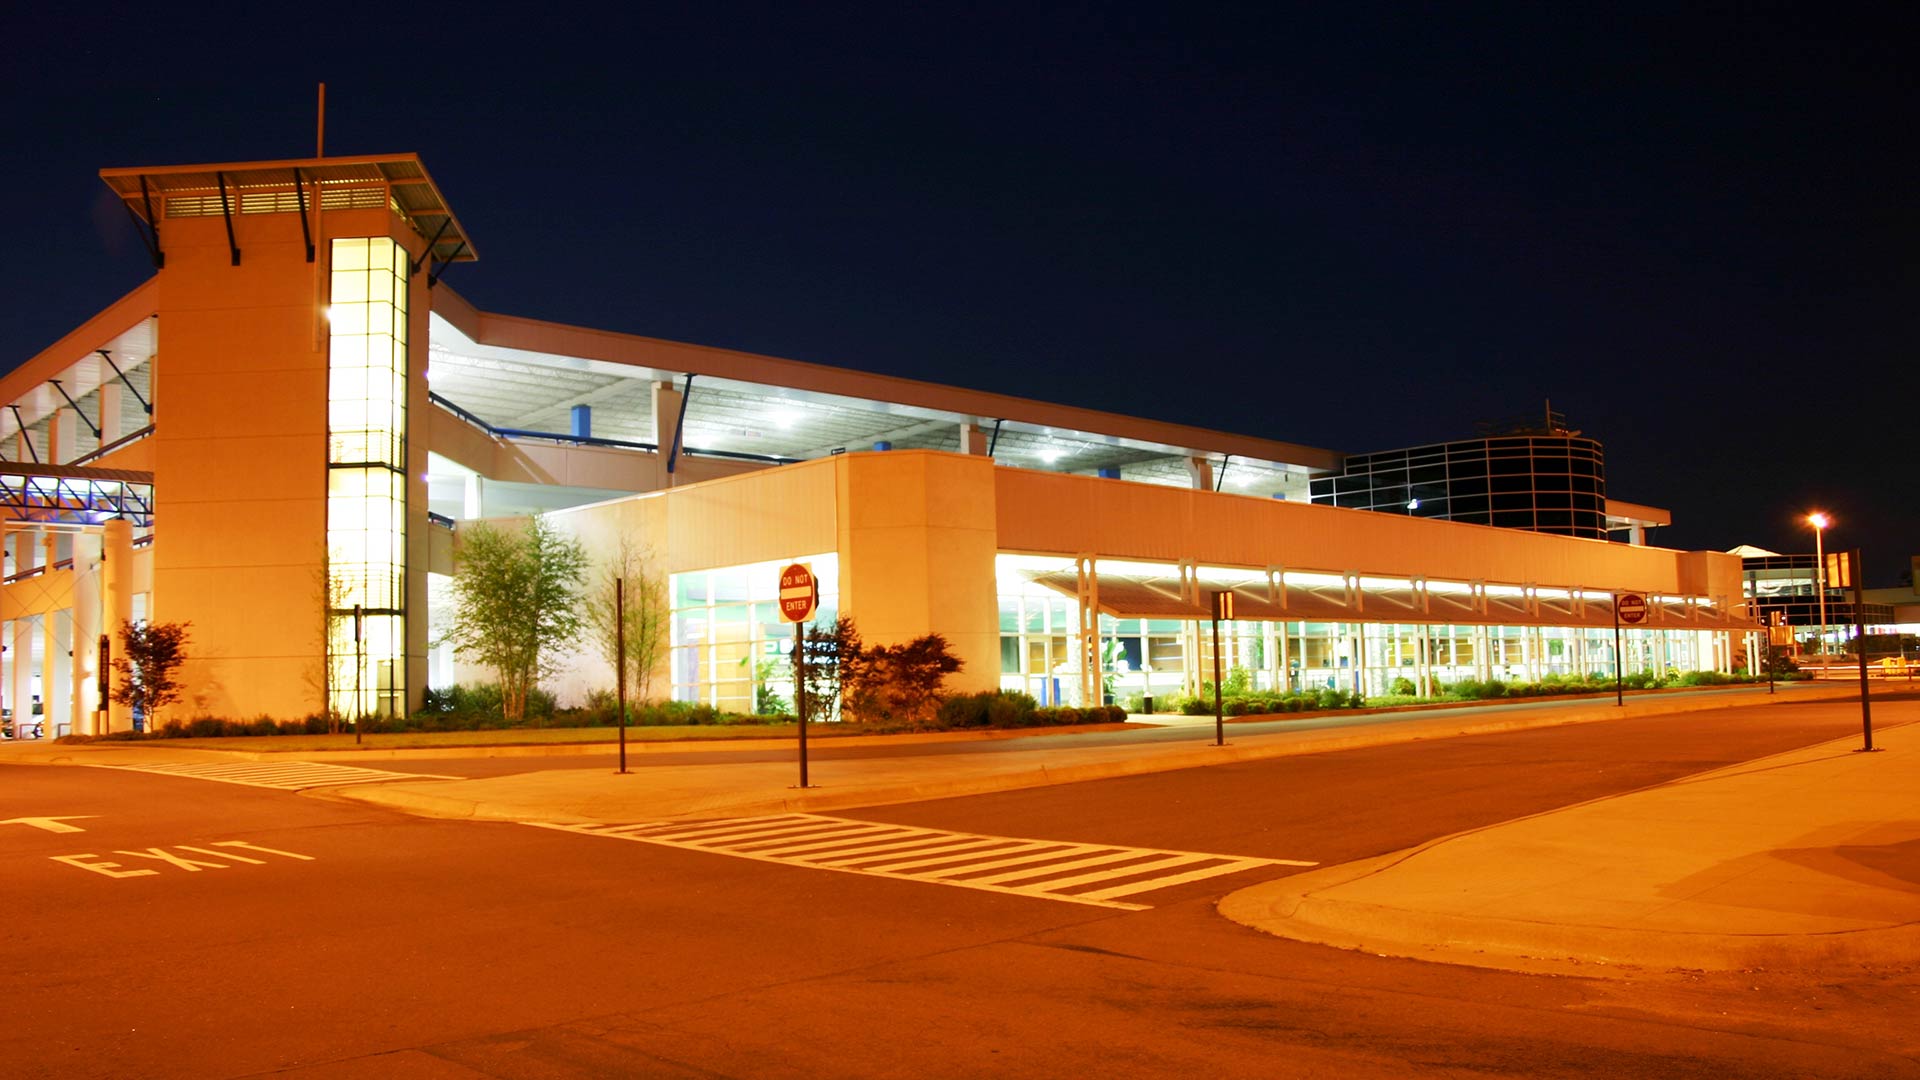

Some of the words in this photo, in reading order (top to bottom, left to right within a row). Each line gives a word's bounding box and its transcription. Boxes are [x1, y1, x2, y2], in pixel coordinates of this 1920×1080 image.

[782, 576, 792, 586] DO
[795, 574, 808, 584] NOT
[786, 600, 807, 611] ENTER
[48, 840, 316, 878] EXIT
